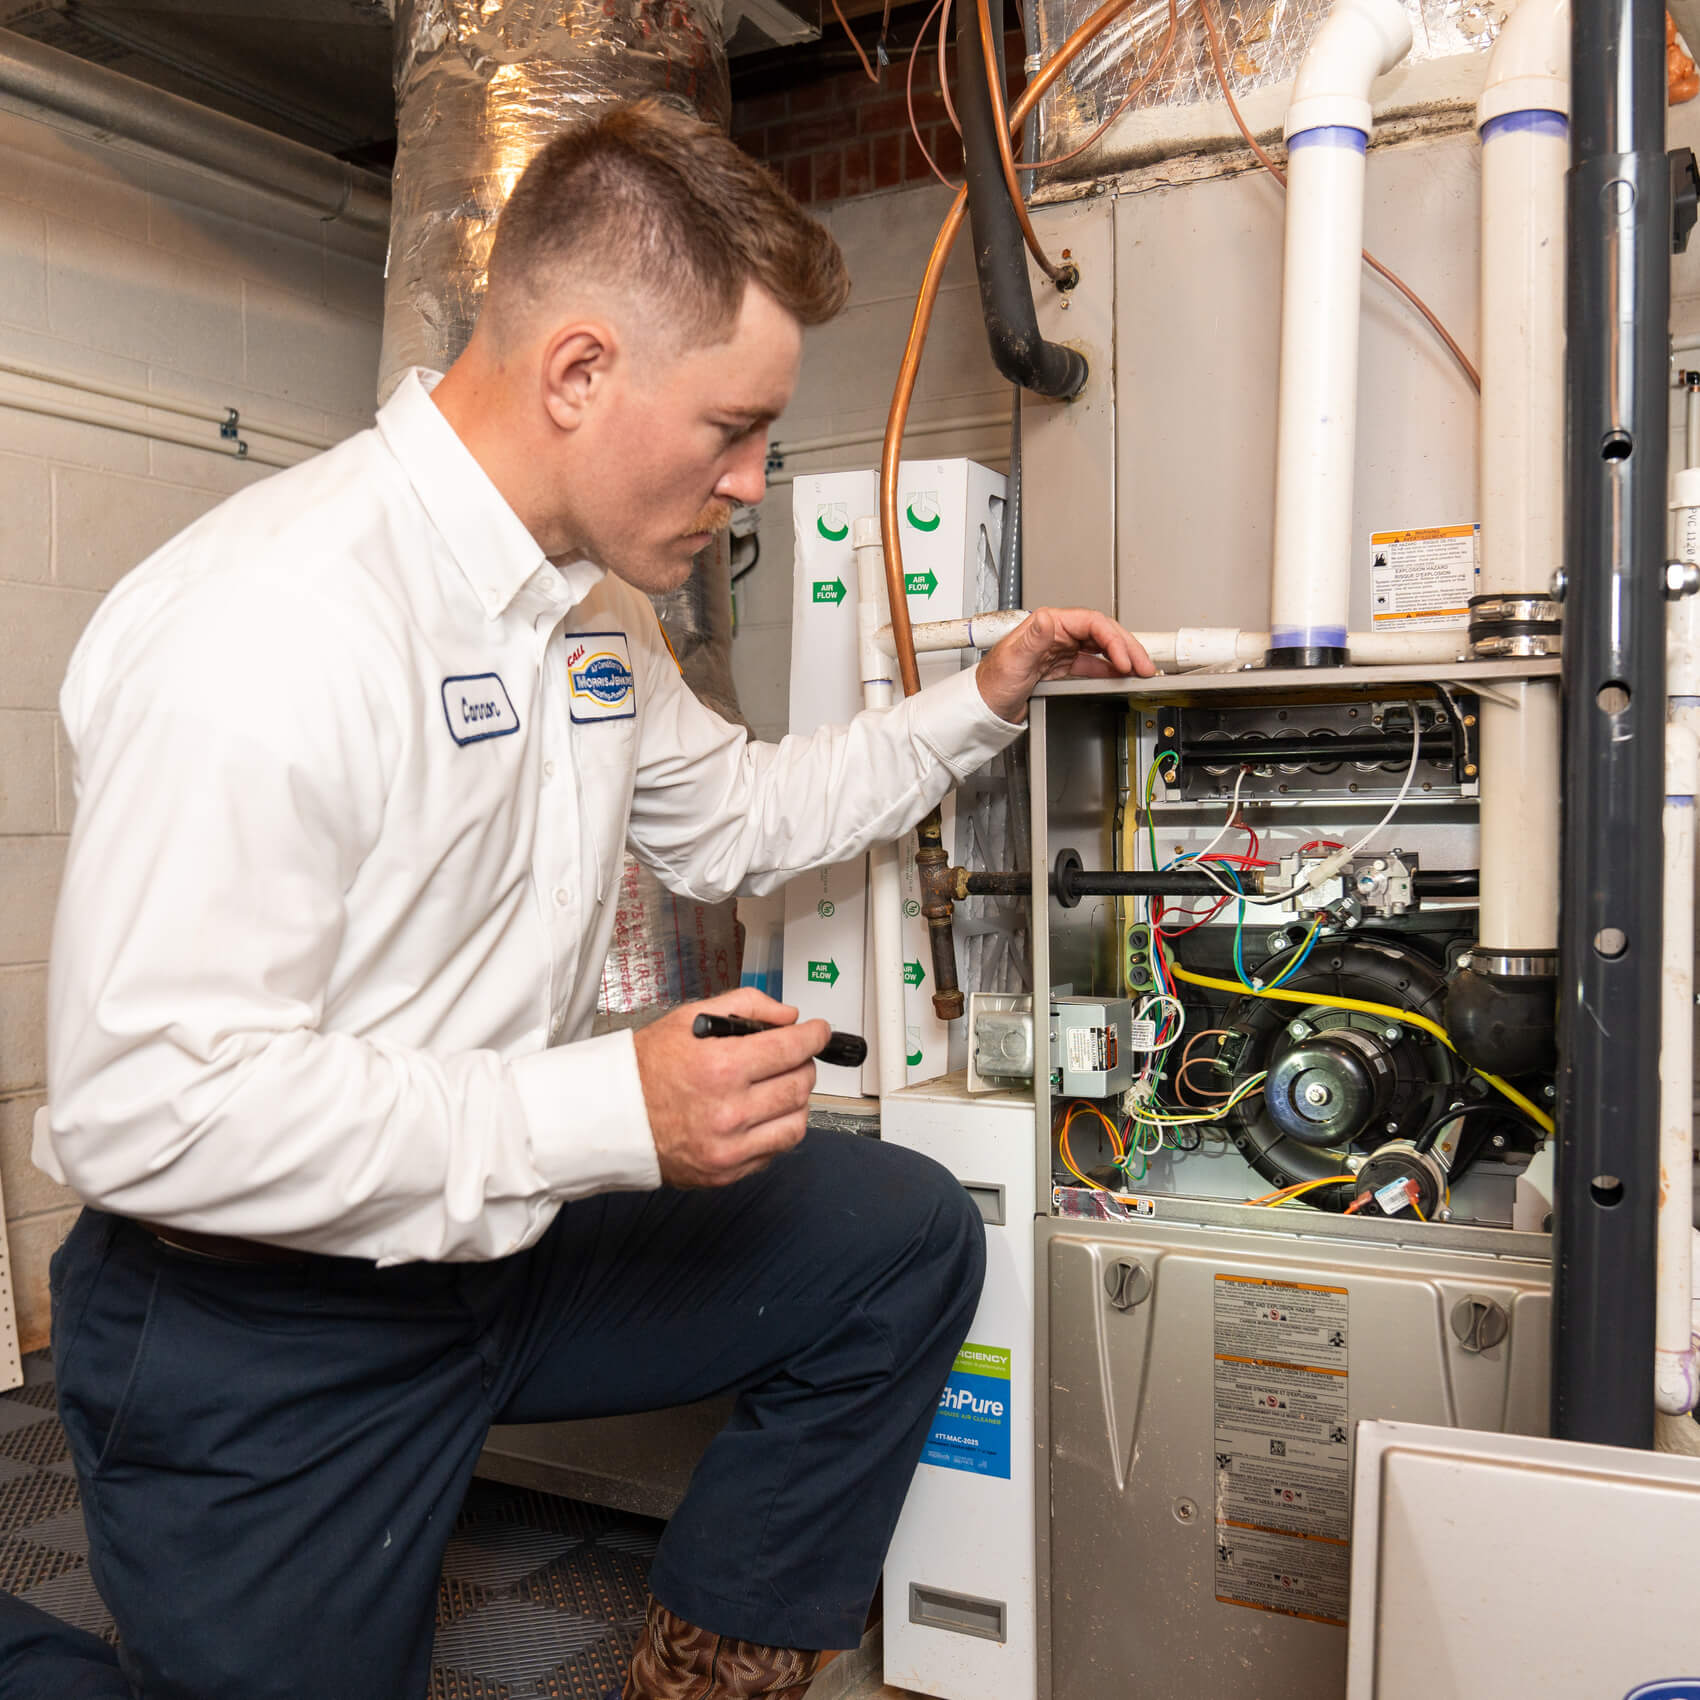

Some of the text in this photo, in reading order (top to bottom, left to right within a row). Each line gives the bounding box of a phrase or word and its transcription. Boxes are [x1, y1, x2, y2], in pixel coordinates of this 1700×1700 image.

[1688, 507, 1697, 527] PVC
[908, 584, 930, 592] FLOW
[568, 644, 585, 668] CALL
[632, 902, 644, 920] 75
[652, 950, 668, 987] FHC
[812, 972, 832, 980] FLOW
